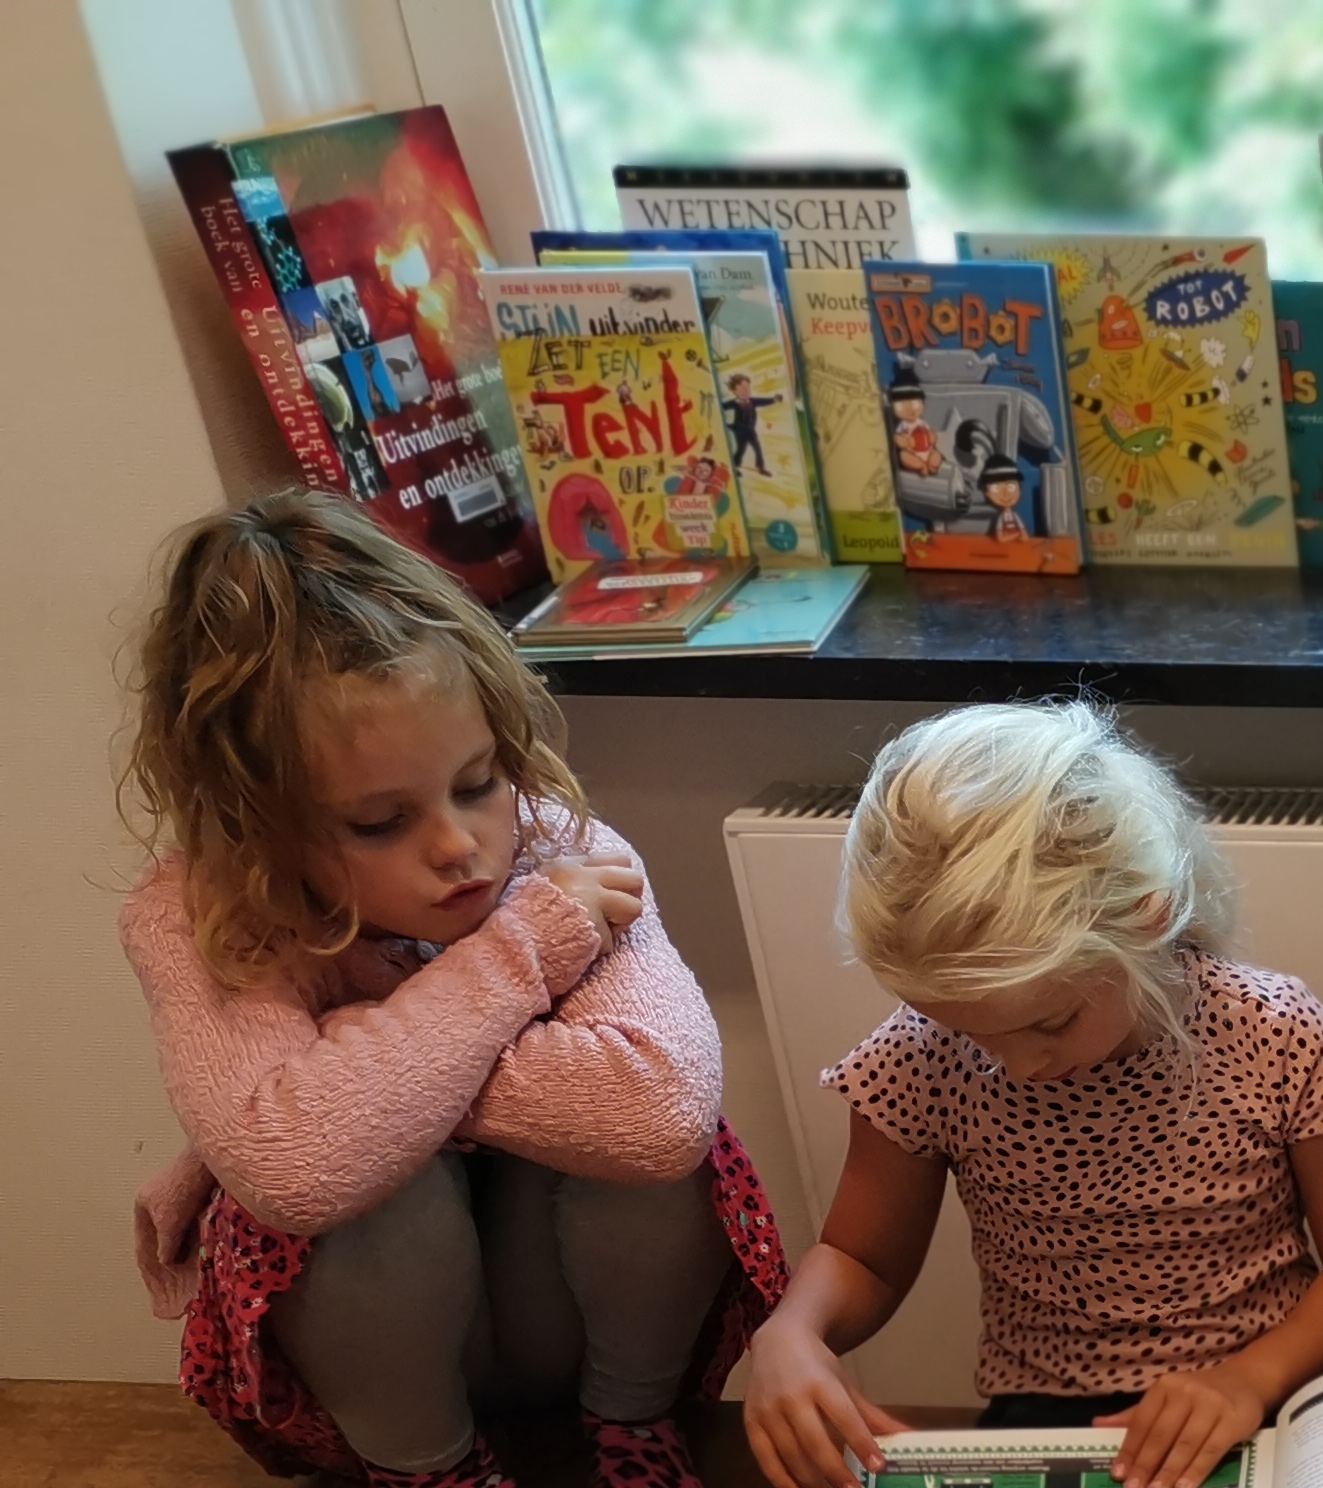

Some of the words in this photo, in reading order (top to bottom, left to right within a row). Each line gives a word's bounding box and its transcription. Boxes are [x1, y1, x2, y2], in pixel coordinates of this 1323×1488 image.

[637, 198, 898, 232] WETENSCHAP
[201, 206, 228, 252] boek
[223, 261, 244, 293] van
[784, 239, 902, 270] HNIEK
[534, 283, 563, 295] VAN
[568, 283, 585, 295] DER
[587, 282, 623, 294] VELDE
[720, 267, 752, 281] Dam
[1177, 280, 1203, 296] TOT
[806, 291, 869, 311] Woute
[1156, 281, 1239, 321] ROBOT
[589, 307, 696, 337] uitvinder
[811, 317, 870, 341] Keepv
[516, 328, 592, 376] ZET
[595, 349, 641, 380] EEN
[260, 304, 339, 482] Uitvindingen
[430, 380, 456, 402] Het
[455, 368, 484, 396] grote
[484, 358, 502, 383] boe
[239, 307, 259, 338] en
[259, 353, 320, 488] ontdekkin
[375, 407, 488, 466] Uitvindingen
[398, 486, 424, 511] en
[842, 534, 900, 550] Leopold
